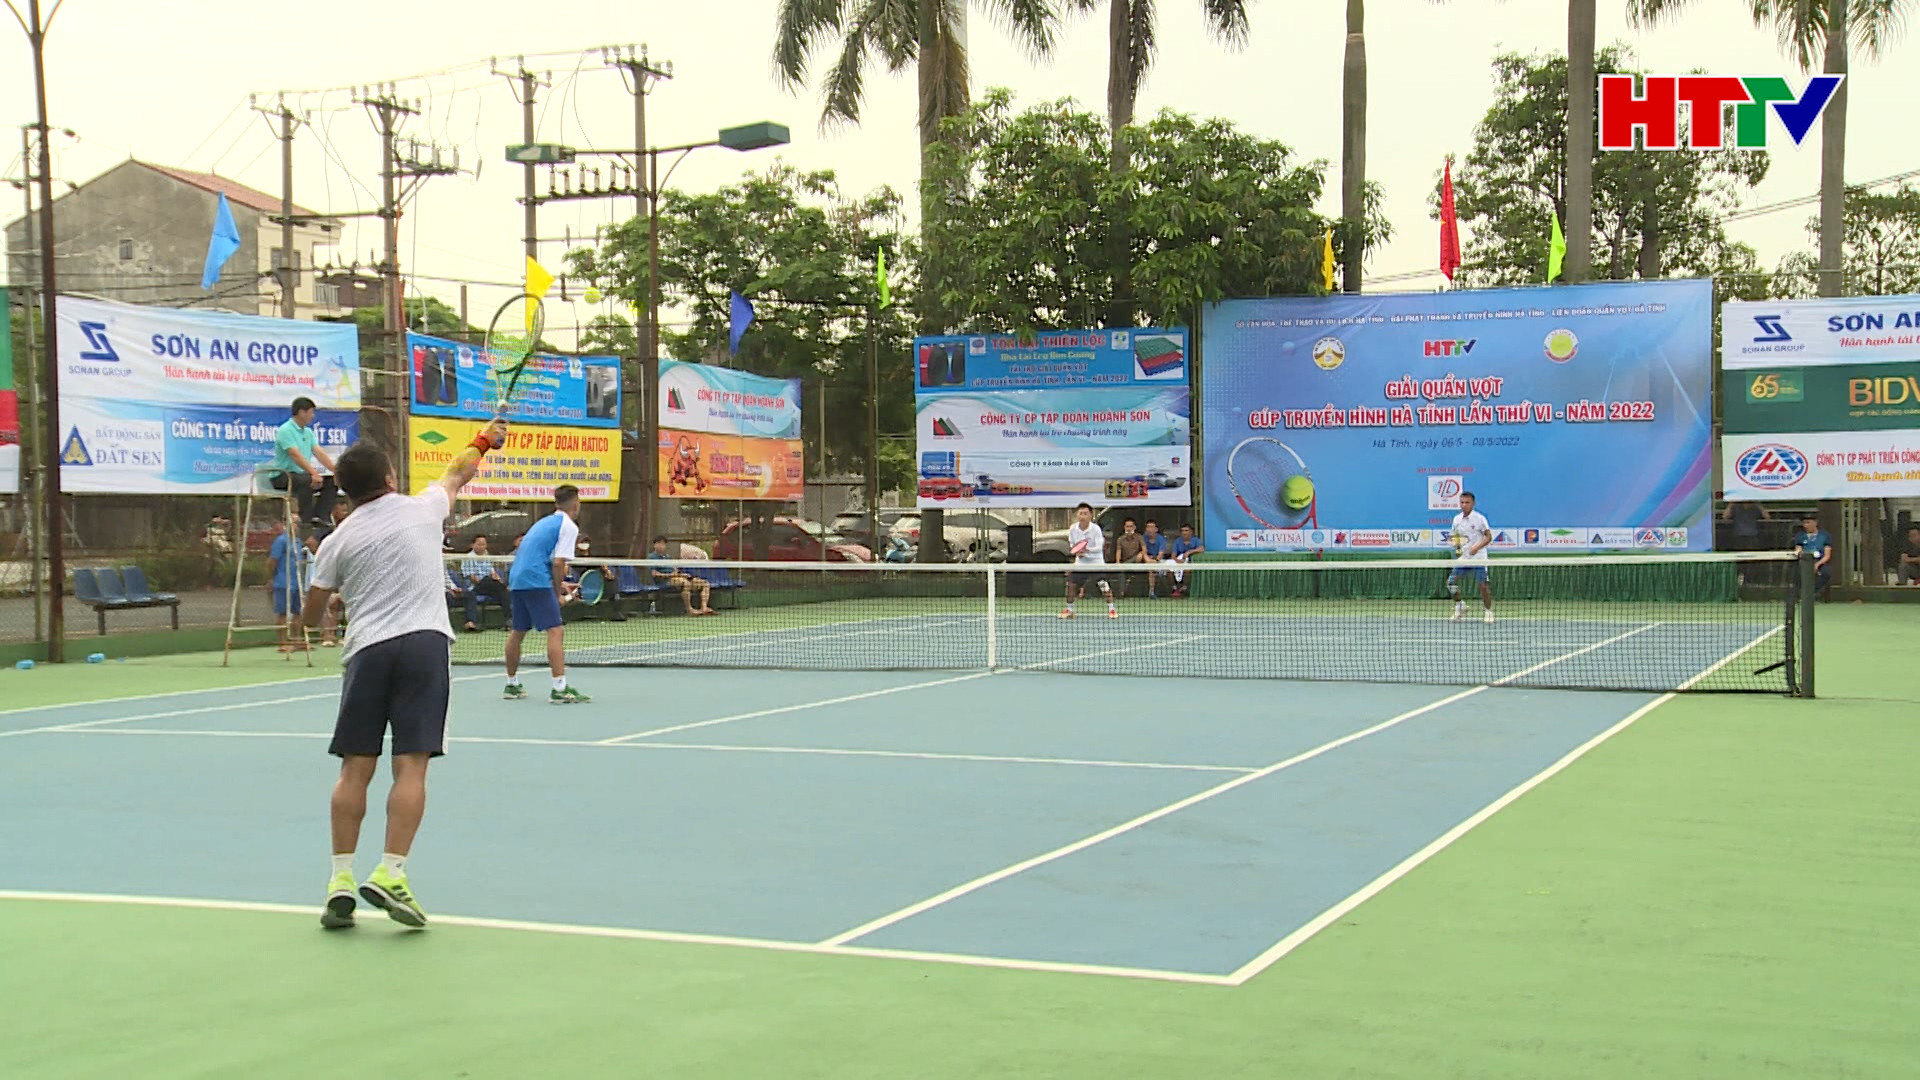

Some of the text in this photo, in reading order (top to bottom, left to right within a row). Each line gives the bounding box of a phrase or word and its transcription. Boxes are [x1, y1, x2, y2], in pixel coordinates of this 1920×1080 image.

[1828, 311, 1920, 333] SƠN A
[151, 333, 319, 366] SƠN AN GROUP
[1042, 334, 1079, 348] THIÊN
[1082, 333, 1106, 349] LỘC
[1424, 339, 1477, 358] HTTV
[1774, 344, 1806, 352] GROUP
[1865, 337, 1894, 348] hạnh
[68, 365, 132, 378] SONAN GROUP
[1385, 373, 1503, 400] GIẢI QUẦN VỢT
[1751, 373, 1781, 398] 65
[980, 409, 1151, 426] CÔNG TY CP TẬP ĐOÀN HOÀNH SƠN
[1249, 406, 1281, 429] CÚP
[1283, 403, 1346, 428] TRUYỀN
[1349, 405, 1387, 427] HÌNH
[1391, 403, 1414, 426] HÀ
[1417, 402, 1456, 426] TĨNH
[1459, 400, 1493, 425] LẦN
[1496, 400, 1533, 424] THỨ
[1535, 404, 1552, 422] VI
[1566, 399, 1606, 423] NĂM
[1609, 402, 1655, 422] 2022
[172, 417, 204, 439] CÔNG
[206, 423, 222, 440] TY
[225, 417, 246, 441] BẤT
[328, 429, 347, 445] SEN
[507, 431, 609, 453] TY CP TẬP ĐOÀN HATICO
[1373, 439, 1386, 448] Hà
[1416, 438, 1437, 449] ngày
[96, 443, 162, 466] ĐẤT SEN
[415, 451, 452, 462] HATICO
[1010, 460, 1031, 468] CÔNG
[1033, 460, 1041, 468] TY
[1816, 450, 1835, 466] CÔNG
[1837, 453, 1846, 465] TY
[1848, 453, 1857, 465] CP
[1859, 450, 1876, 465] PHÁT
[1879, 444, 1899, 464] TRIỂN
[1391, 531, 1420, 543] BIDV
